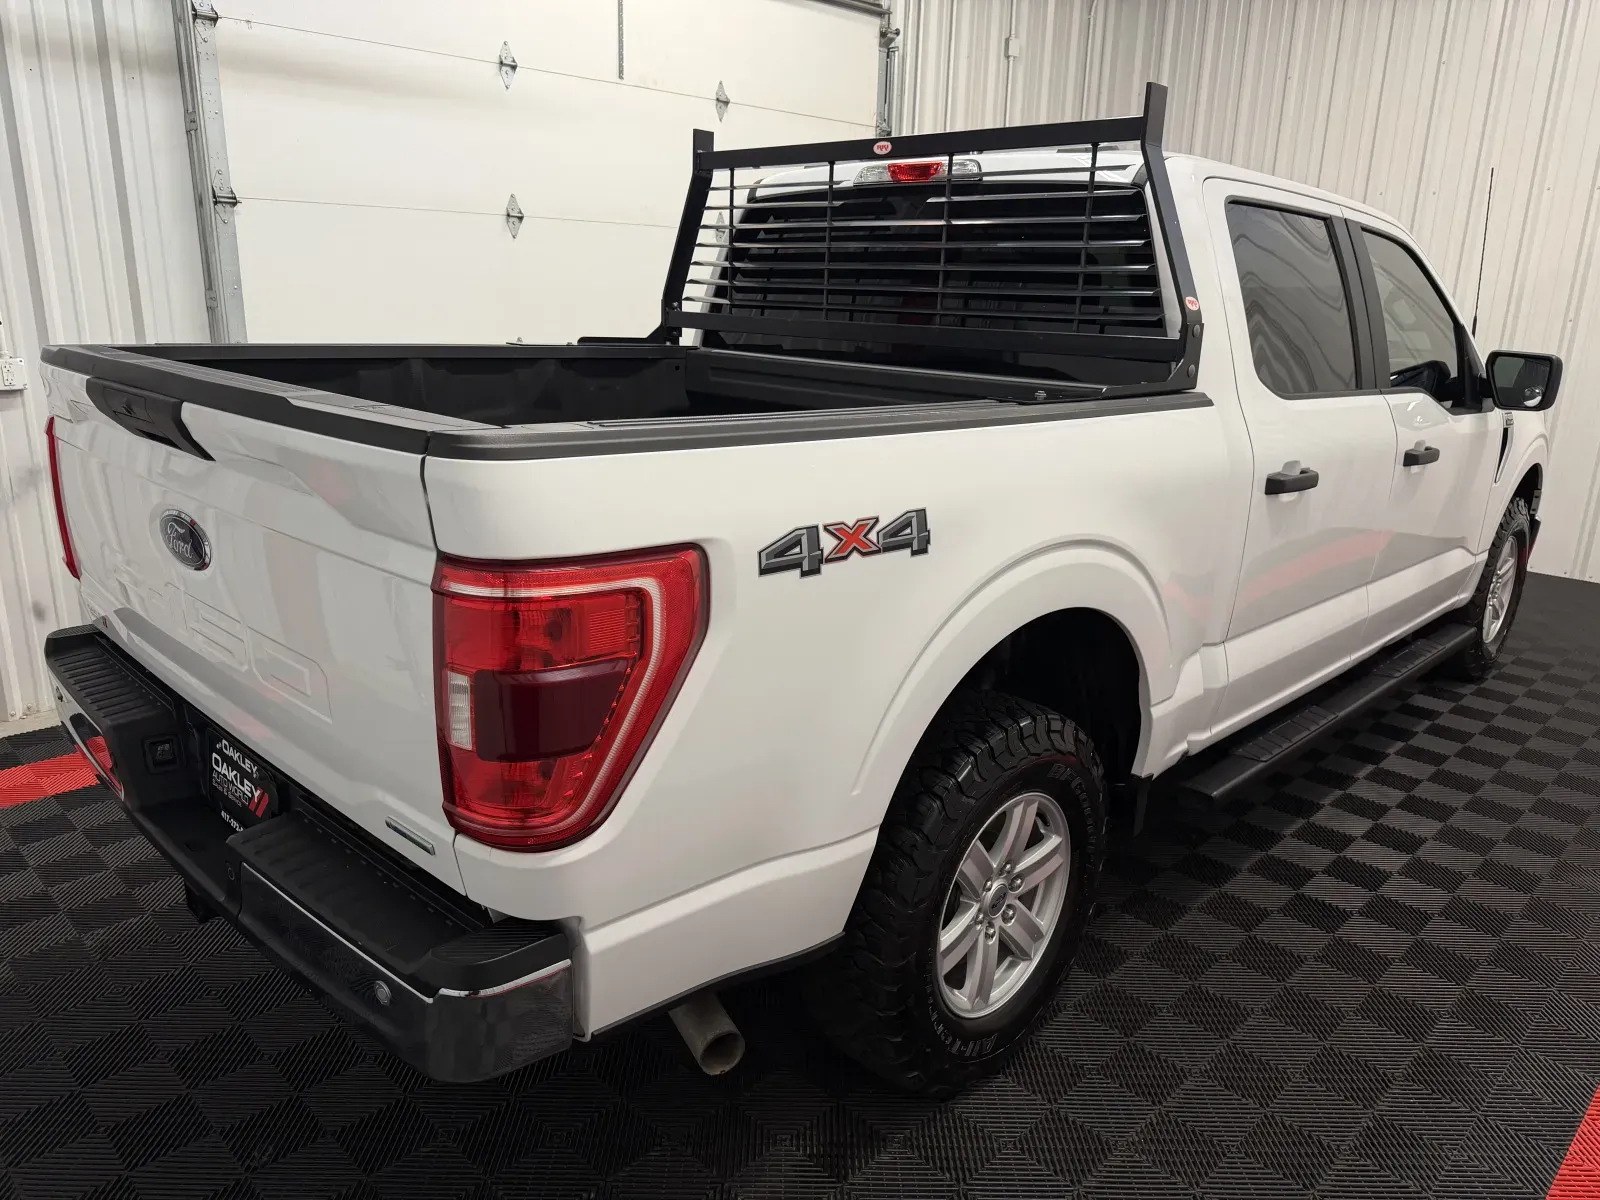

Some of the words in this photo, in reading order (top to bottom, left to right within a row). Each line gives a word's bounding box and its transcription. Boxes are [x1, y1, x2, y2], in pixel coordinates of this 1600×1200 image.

[165, 521, 194, 559] Ford
[222, 739, 258, 774] OAKLEY
[212, 752, 261, 803] OAKLEY
[212, 770, 228, 787] AUTO
[228, 782, 249, 805] WORLD
